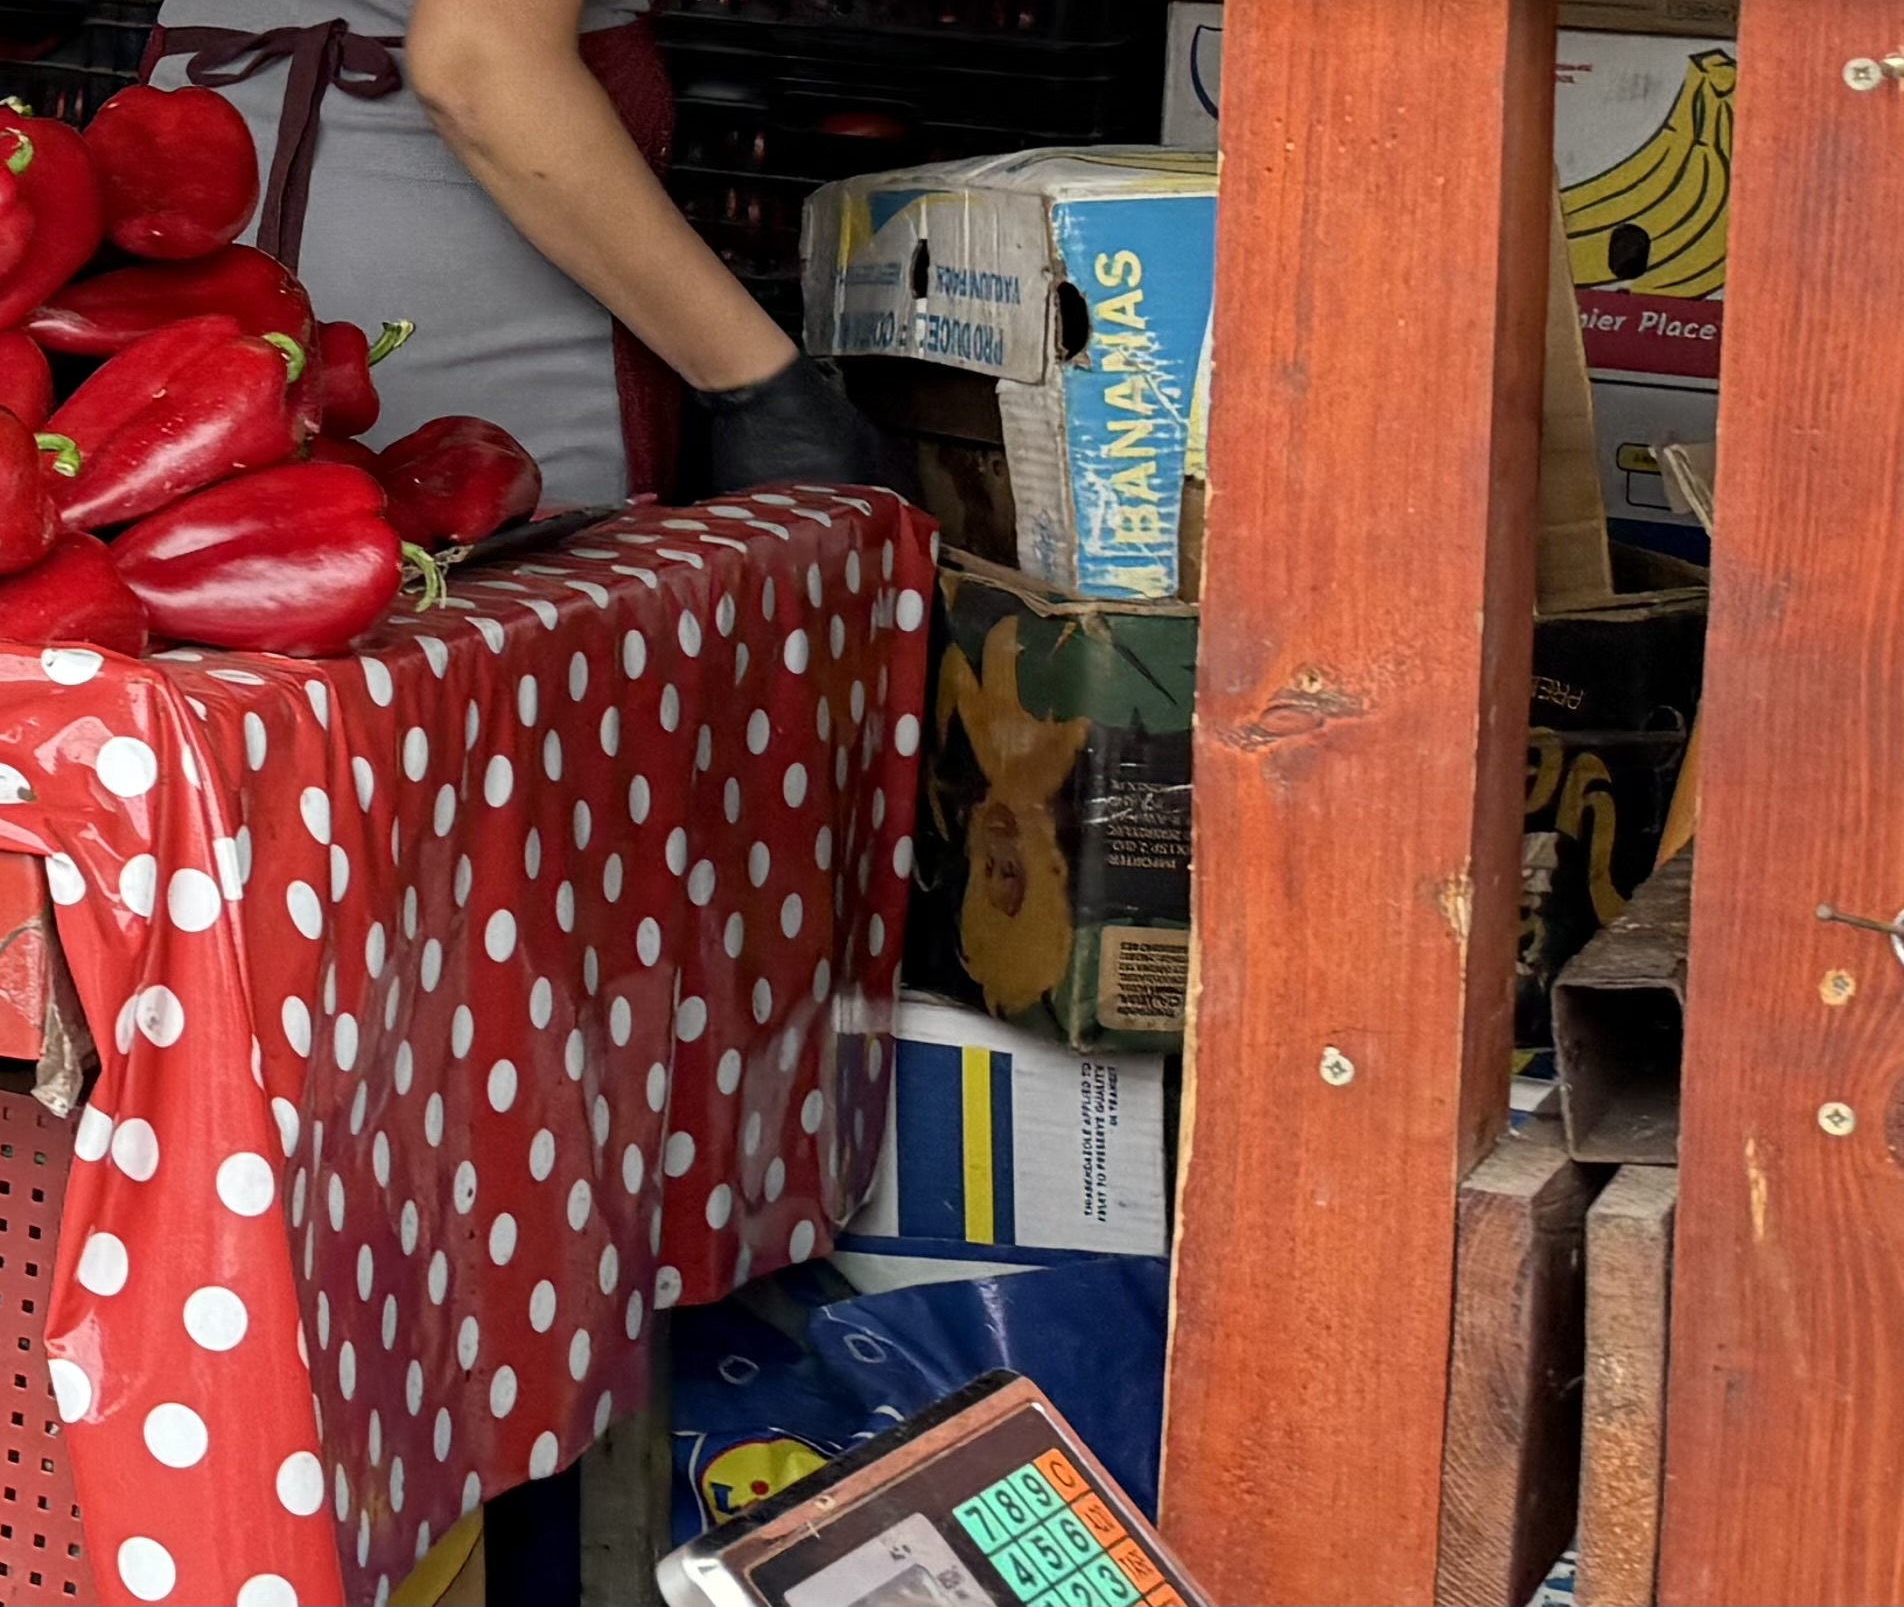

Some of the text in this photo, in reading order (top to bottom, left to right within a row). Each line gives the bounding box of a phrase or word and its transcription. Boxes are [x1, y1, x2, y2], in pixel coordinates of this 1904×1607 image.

[927, 315, 1004, 366] PRODUCE
[1638, 310, 1718, 338] Place
[1093, 249, 1165, 546] BANANAS
[963, 1460, 1076, 1543] 7 8 9 C
[1009, 1553, 1039, 1589] 4
[1030, 1535, 1064, 1571] 5
[1060, 1518, 1090, 1553] 6
[1097, 1564, 1129, 1599] 3
